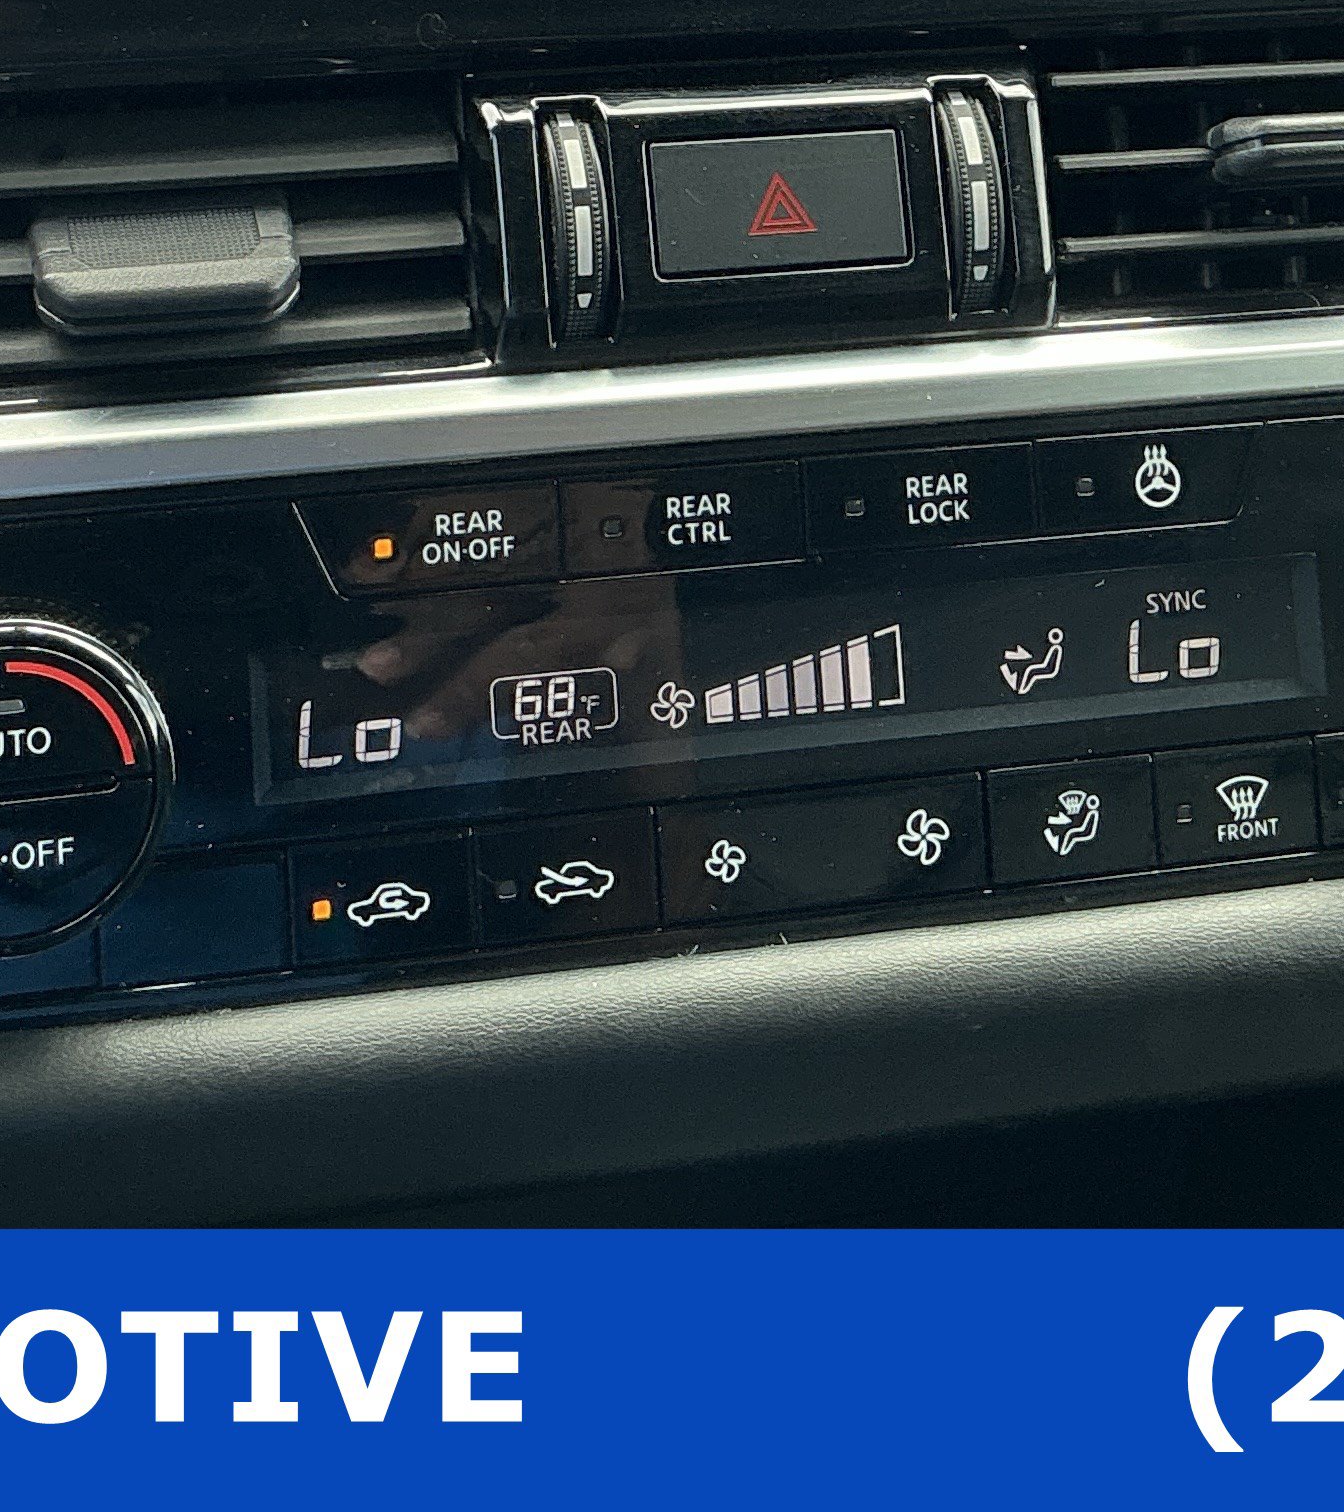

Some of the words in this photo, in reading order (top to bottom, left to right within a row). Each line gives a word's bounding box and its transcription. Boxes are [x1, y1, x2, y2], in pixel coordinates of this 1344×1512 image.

[905, 471, 970, 499] REAR
[665, 492, 732, 520] REAR
[907, 499, 971, 526] LOCK
[434, 508, 504, 537] REAR
[666, 519, 732, 547] CTRL
[1145, 589, 1207, 615] SYNC
[521, 718, 593, 747] REAR
[1216, 817, 1280, 844] FRONT
